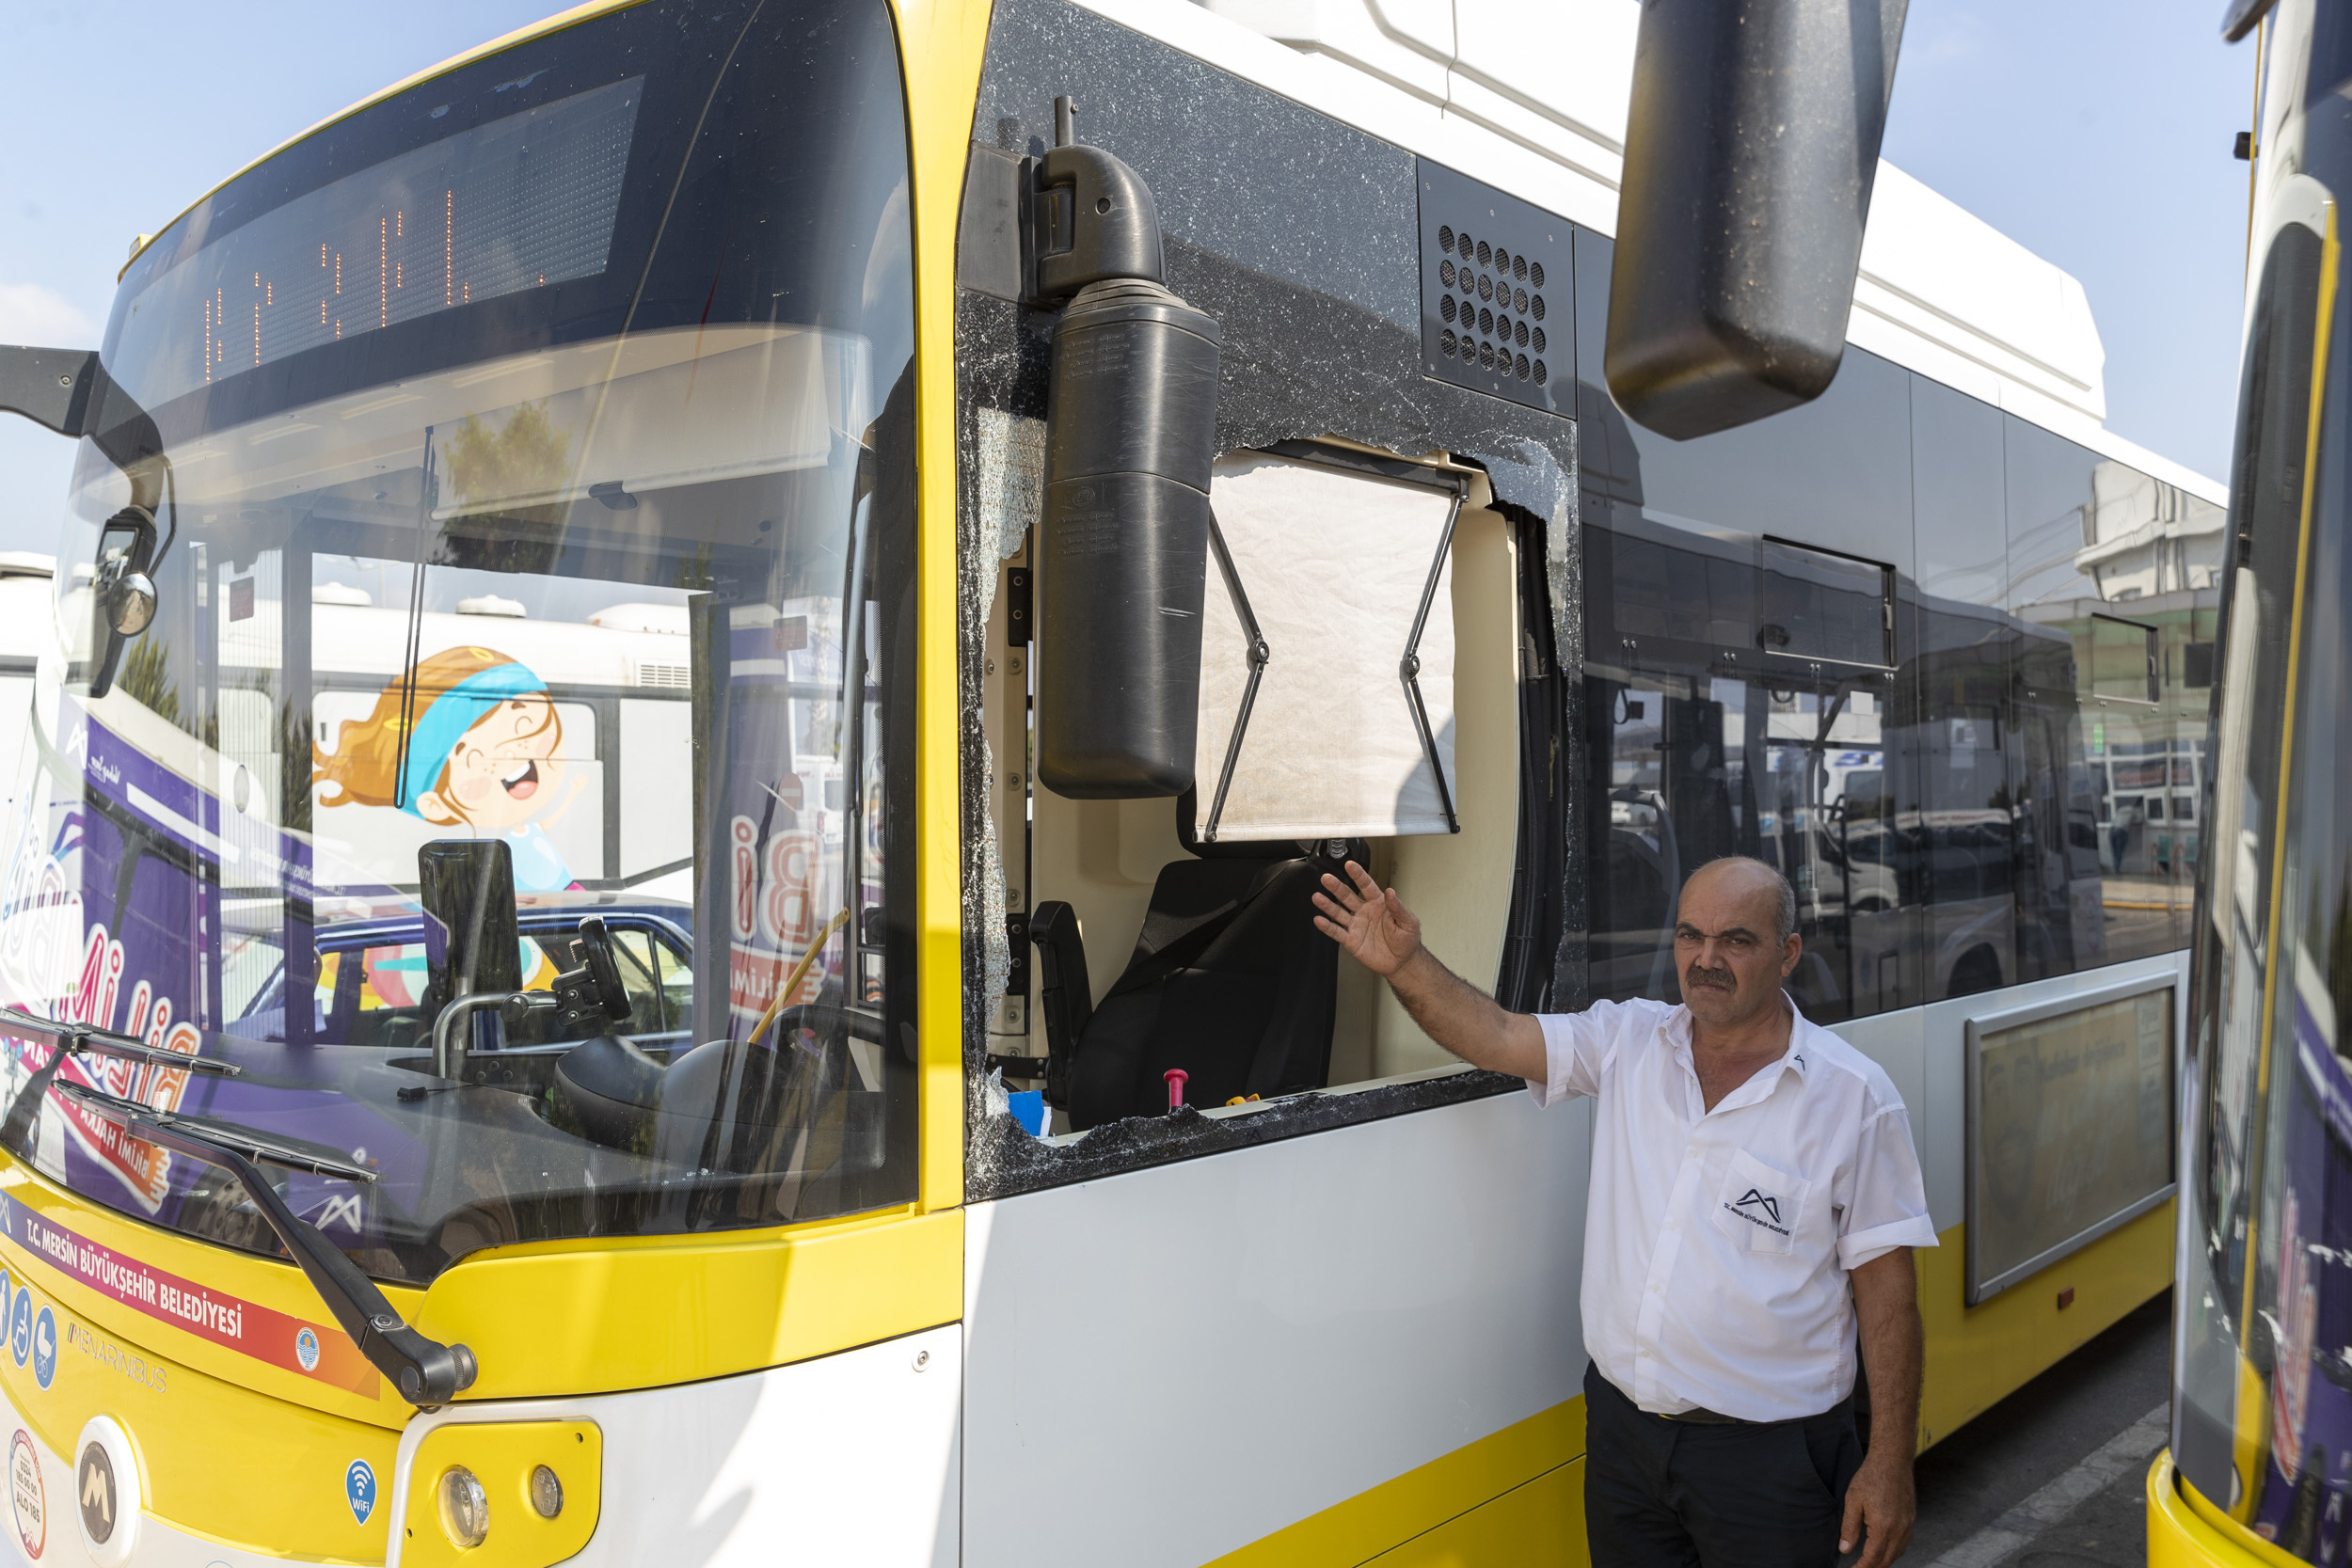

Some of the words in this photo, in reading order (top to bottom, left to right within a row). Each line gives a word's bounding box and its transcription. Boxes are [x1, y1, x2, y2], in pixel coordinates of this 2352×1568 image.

[26, 1218, 41, 1246] T.C.
[41, 1229, 78, 1269] MERSİN
[80, 1244, 156, 1306] BÜYÜKŞEHİR
[160, 1283, 242, 1339] BELEDİYESİ
[352, 1497, 370, 1513] WiFi
